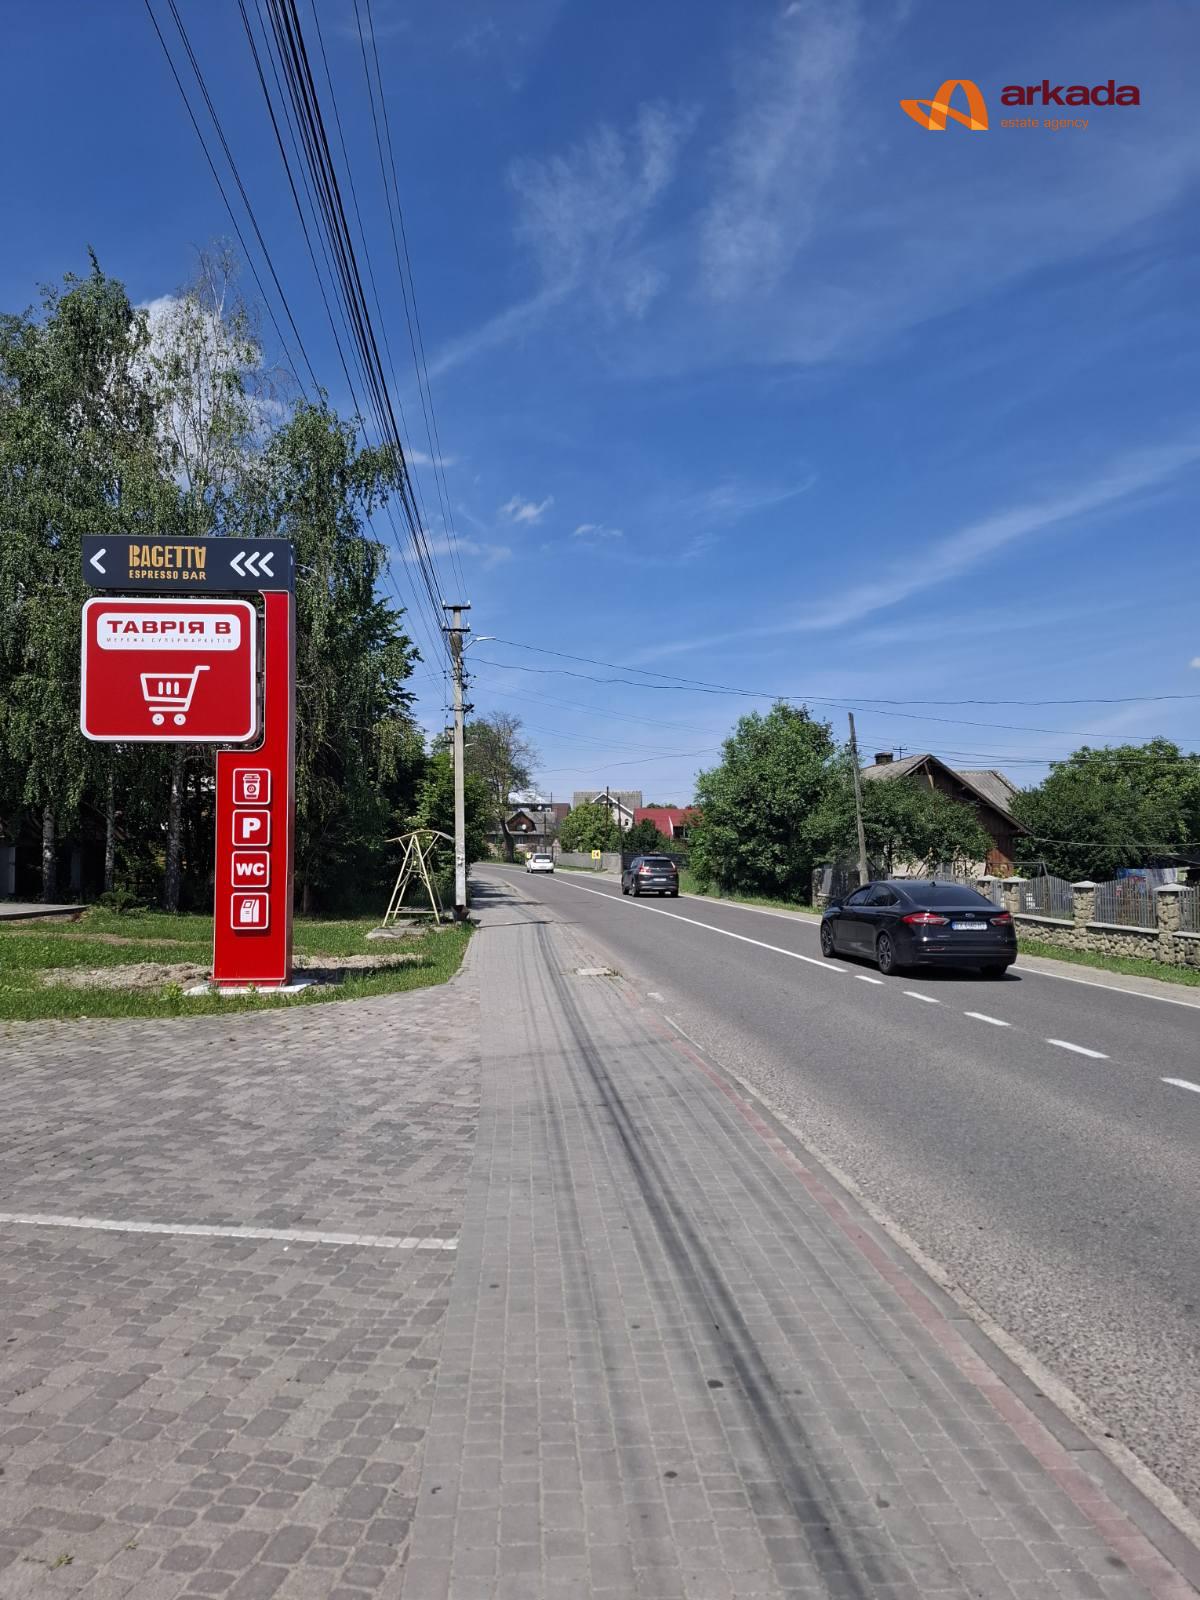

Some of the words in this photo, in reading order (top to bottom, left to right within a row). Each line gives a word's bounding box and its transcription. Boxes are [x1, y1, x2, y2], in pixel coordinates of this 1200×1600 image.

[129, 569, 179, 580] ESPRESSO
[182, 570, 207, 580] BAR
[107, 620, 205, 634] ТАВРІЯ
[215, 621, 232, 634] В
[242, 817, 261, 838] P
[235, 862, 265, 876] WC
